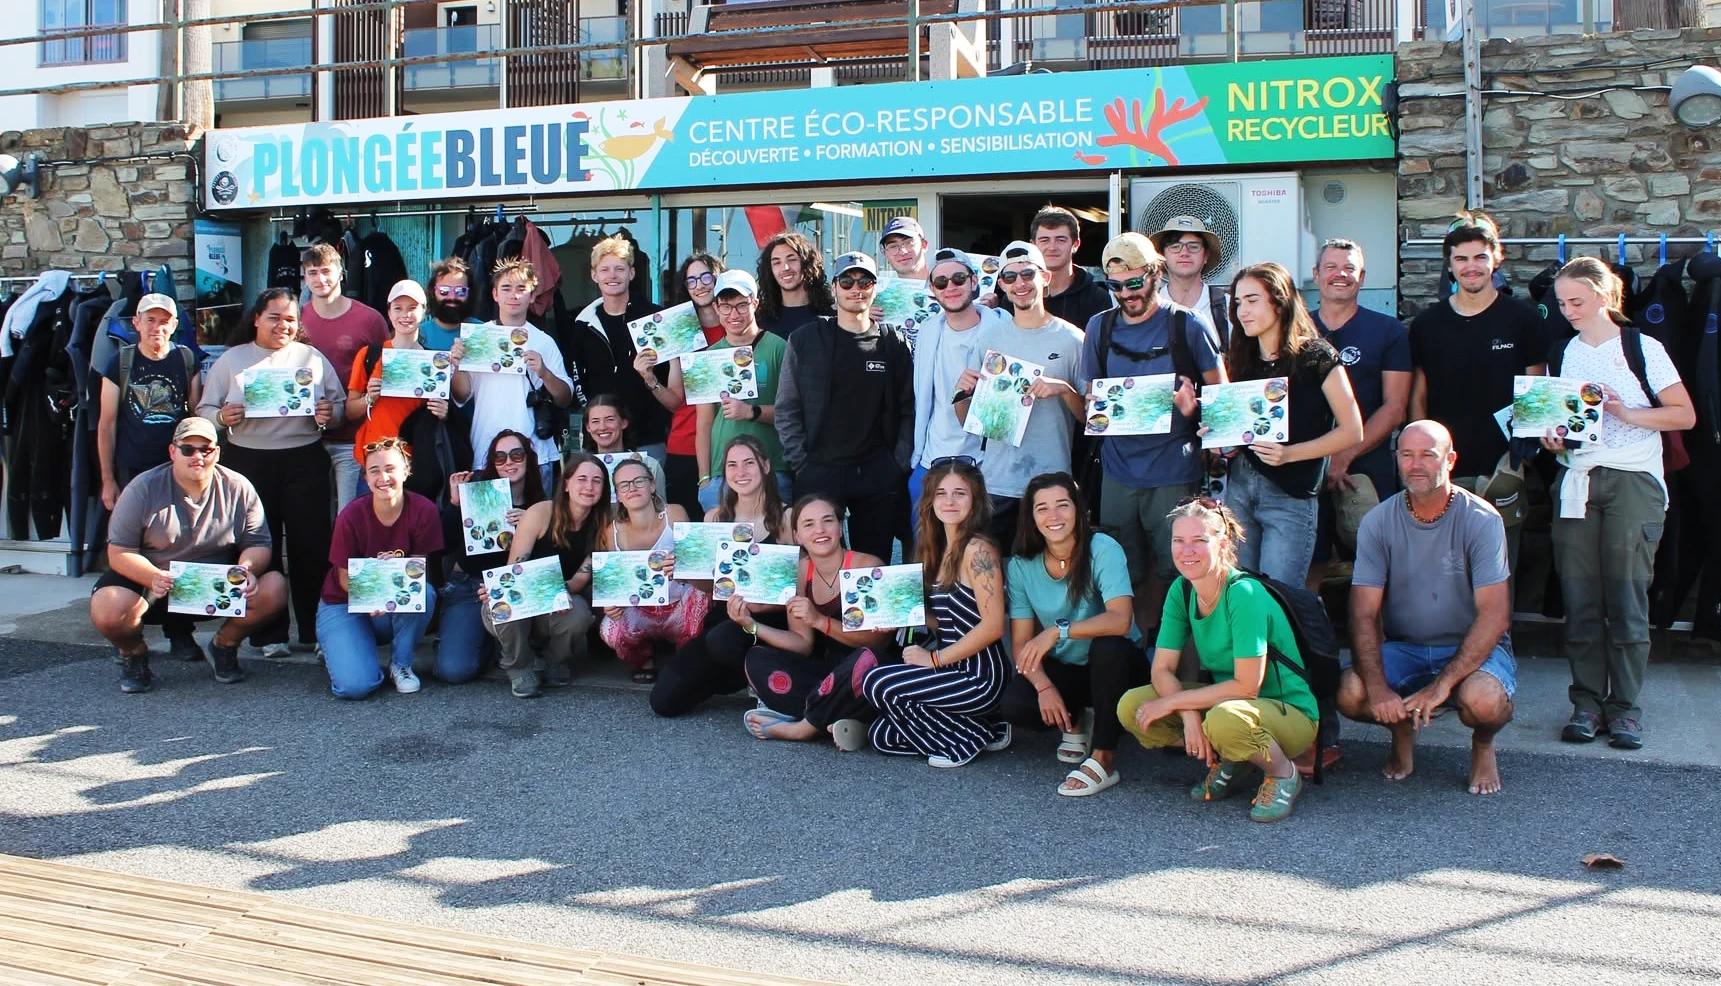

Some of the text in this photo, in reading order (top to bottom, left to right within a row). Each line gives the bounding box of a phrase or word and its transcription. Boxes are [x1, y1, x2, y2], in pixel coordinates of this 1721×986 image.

[1228, 76, 1382, 112] NITROX
[690, 99, 1093, 144] CENTRE ÉCO-RESPONSABLE
[1228, 114, 1390, 141] RECYCLEUR
[690, 132, 1092, 167] DÉCOUVERTE FORMATION SENSIBILISATION
